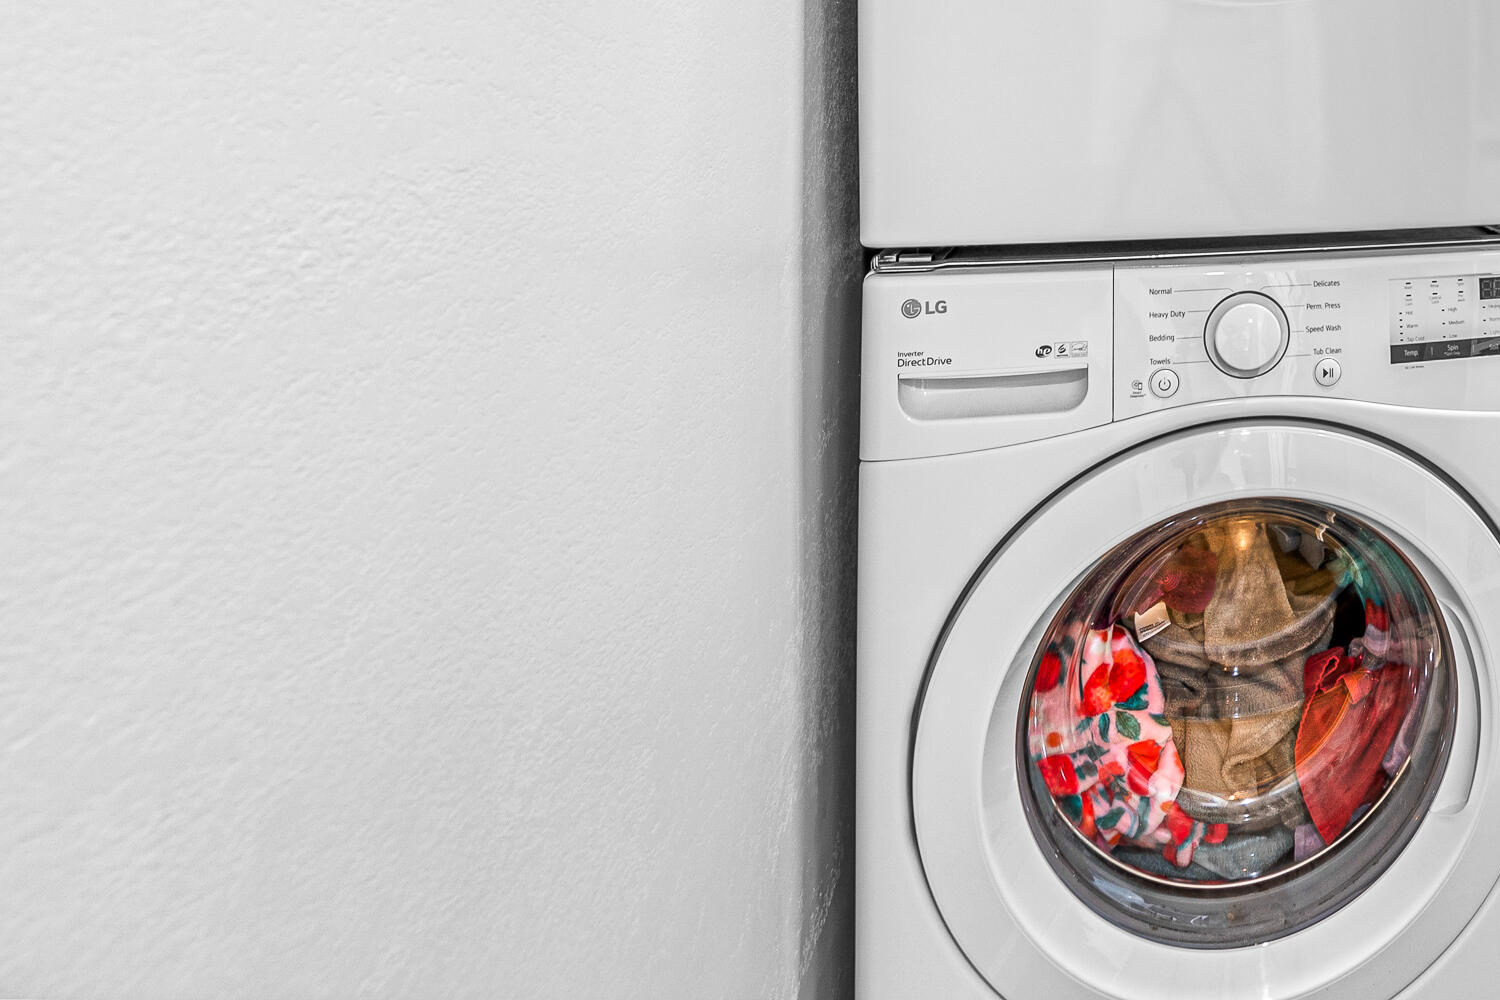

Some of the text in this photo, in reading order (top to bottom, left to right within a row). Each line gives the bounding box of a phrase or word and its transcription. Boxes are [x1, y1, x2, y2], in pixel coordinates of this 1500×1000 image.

[925, 300, 947, 314] LG
[1324, 302, 1341, 310] Press
[1149, 310, 1186, 319] Heavy Duty
[1305, 324, 1342, 334] Speed Wash
[1149, 334, 1175, 343] Bedding
[1325, 347, 1342, 355] Clean
[1447, 344, 1459, 352] Spin
[897, 350, 924, 358] Inverter
